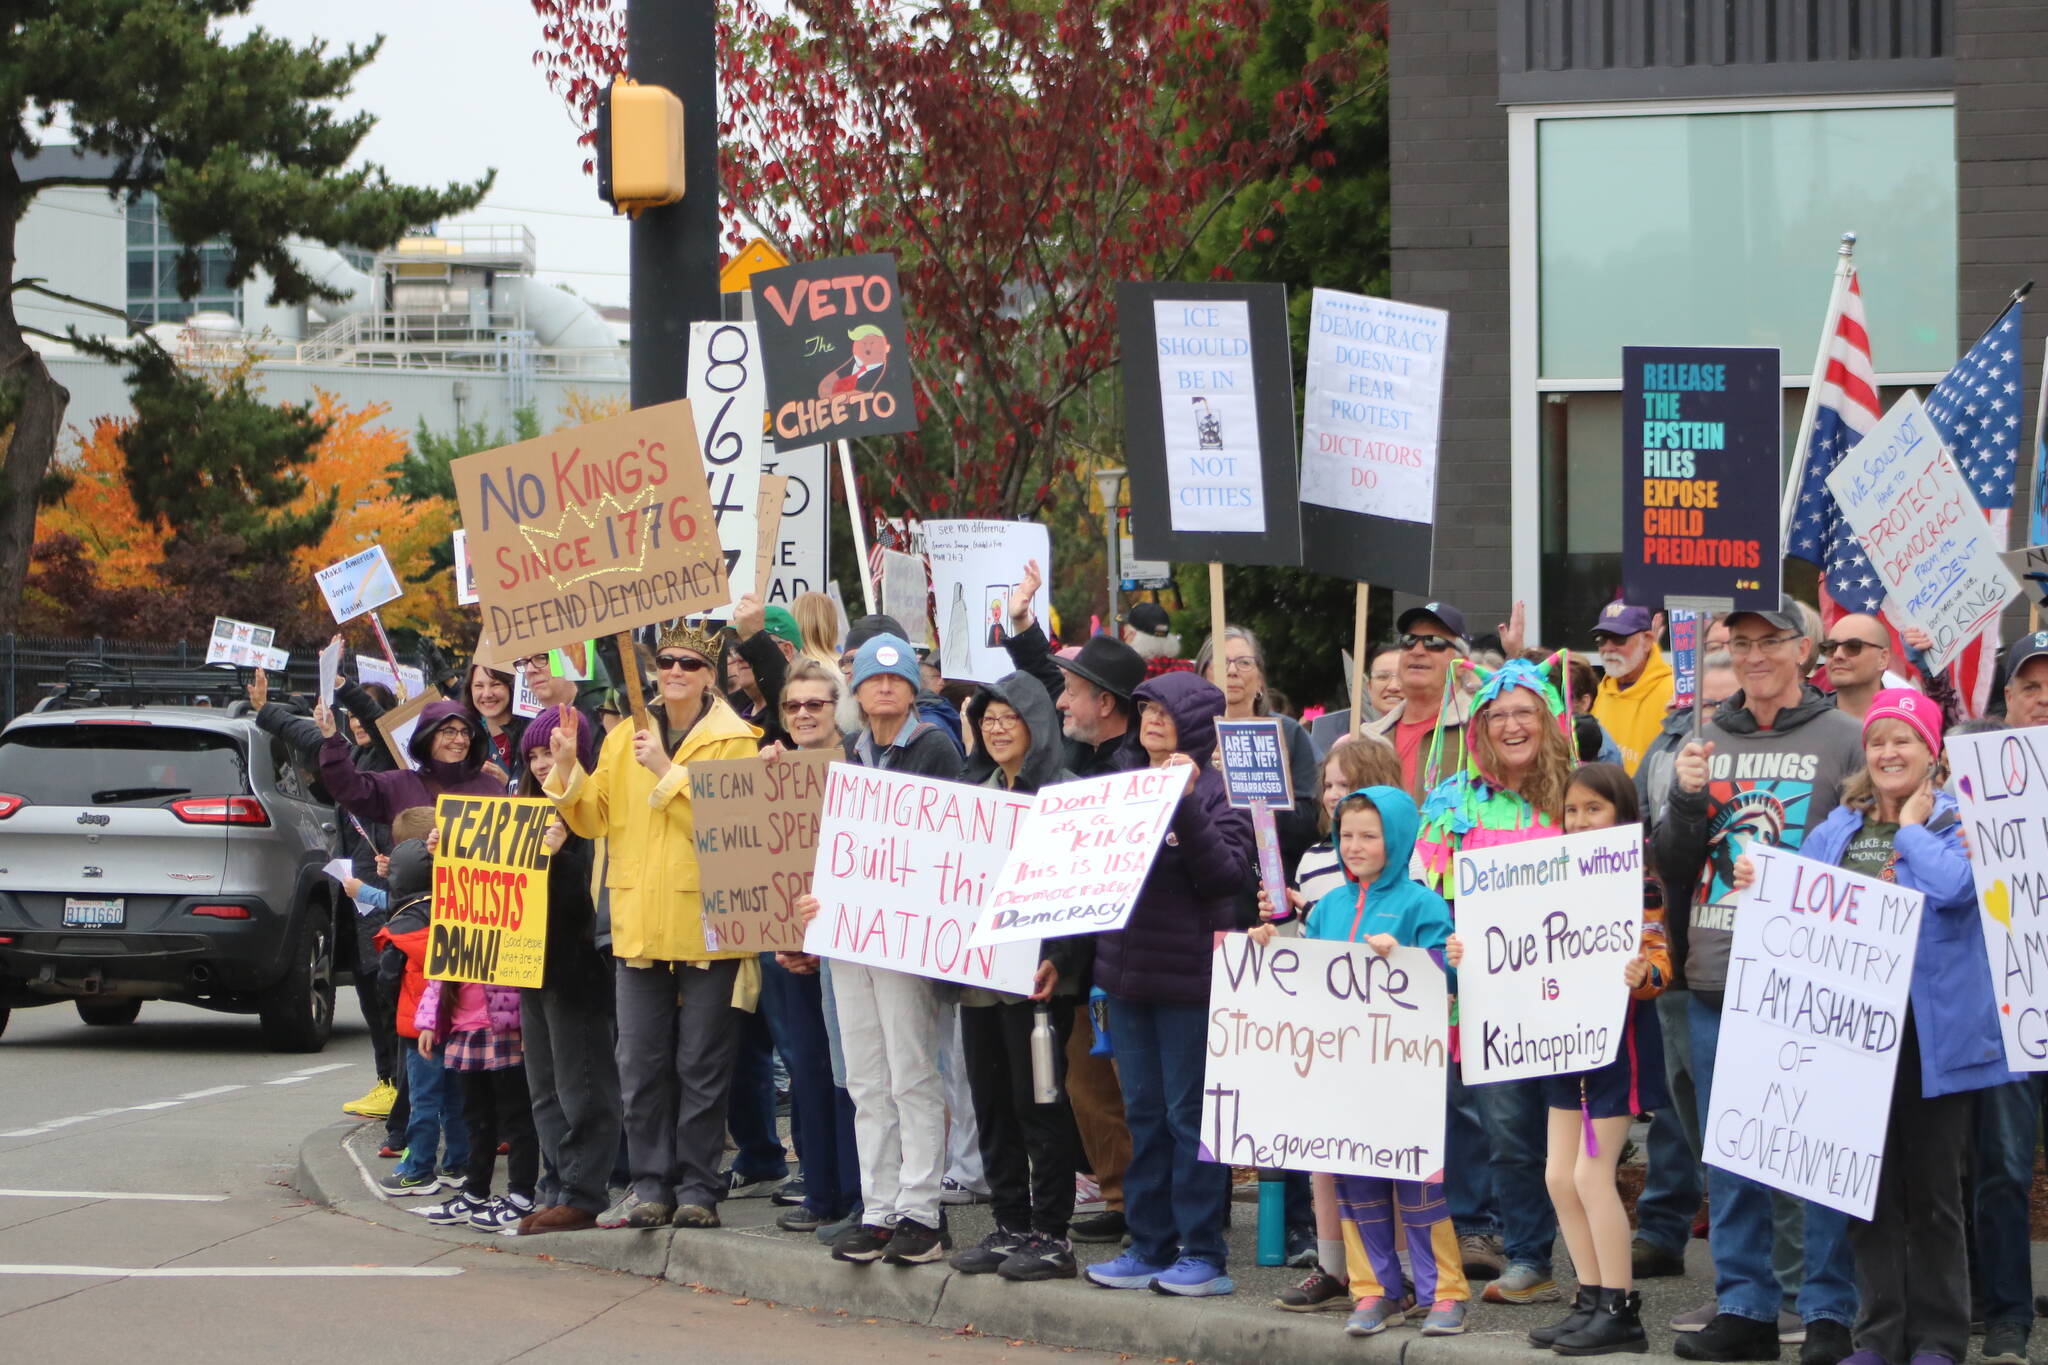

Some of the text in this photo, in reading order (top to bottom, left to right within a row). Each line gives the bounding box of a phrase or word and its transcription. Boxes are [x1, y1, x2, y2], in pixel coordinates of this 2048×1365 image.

[763, 275, 892, 327] VETO
[1184, 307, 1220, 328] ICE
[803, 336, 836, 357] The
[1159, 337, 1249, 357] SHOULD
[1320, 314, 1437, 353] DEMOCRACY
[1336, 345, 1412, 377] DOESN'T
[1178, 370, 1234, 389] BE IN
[1348, 375, 1395, 401] FEAR
[1643, 363, 1726, 392] RELEASE
[775, 391, 896, 439] CHEETO
[1331, 400, 1413, 431] PROTEST
[1643, 392, 1680, 419] THE
[1320, 432, 1423, 468] DICTATORS
[1643, 421, 1725, 450] EPSTEIN
[1191, 457, 1237, 477] NOT
[1351, 467, 1377, 490] DO
[1643, 450, 1696, 478] FILES
[1180, 487, 1252, 508] CITIES
[1643, 479, 1719, 508] EXPOSE
[1842, 475, 1868, 508] WE
[1643, 508, 1704, 537] CHILD
[1869, 461, 1940, 557] PROTECT
[496, 536, 596, 590] SINCE
[606, 495, 697, 559] 1776
[957, 523, 969, 533] no
[1884, 489, 1966, 587] DEMOCRACY
[320, 552, 375, 581] Make America
[1643, 537, 1760, 568] PREDATORS
[490, 593, 587, 647] DEFEND
[589, 557, 721, 623] DEMOCRACY
[1927, 574, 2006, 664] NO KINGS
[1225, 736, 1276, 751] ARE WE
[1226, 752, 1278, 767] GREAT YET?
[1735, 752, 1818, 780] KINGS
[692, 762, 829, 802] WE CAN SPEA
[1123, 775, 1174, 800] ACT
[1231, 782, 1282, 793] EMBARRASSED
[1265, 772, 1280, 781] FEEL
[77, 812, 110, 827] Jeep
[828, 771, 1031, 851] IMMIGRANT
[440, 799, 556, 871] TEAR THE
[696, 812, 819, 855] WE WILL SPEA
[1976, 817, 2026, 866] NOT
[831, 831, 994, 907] Built thi
[1104, 851, 1146, 875] USA
[1578, 839, 1639, 877] without
[434, 866, 527, 932] FASCISTS
[703, 890, 727, 914] WE
[730, 886, 768, 912] MUST
[1753, 853, 1775, 902] I
[1790, 865, 1867, 925] LOVE
[1879, 894, 1918, 935] MY
[504, 933, 521, 948] Good
[715, 922, 745, 945] NO
[832, 903, 995, 980] NATION
[1485, 926, 1538, 975] Due
[1542, 911, 1634, 964] Process
[429, 924, 501, 983] DOWN!
[519, 953, 532, 965] are
[1761, 915, 1902, 985] COUNTRY
[1222, 936, 1419, 1010] We are
[1542, 976, 1560, 1000] is
[1729, 957, 1898, 1053] I AM ASHAMED
[1208, 1008, 1445, 1078] Stronger Than
[1483, 1020, 1608, 1072] Kidnapping
[1778, 1040, 1818, 1074] OF
[1762, 1081, 1808, 1124] MY
[1715, 1108, 1881, 1206] GOVERNMENT
